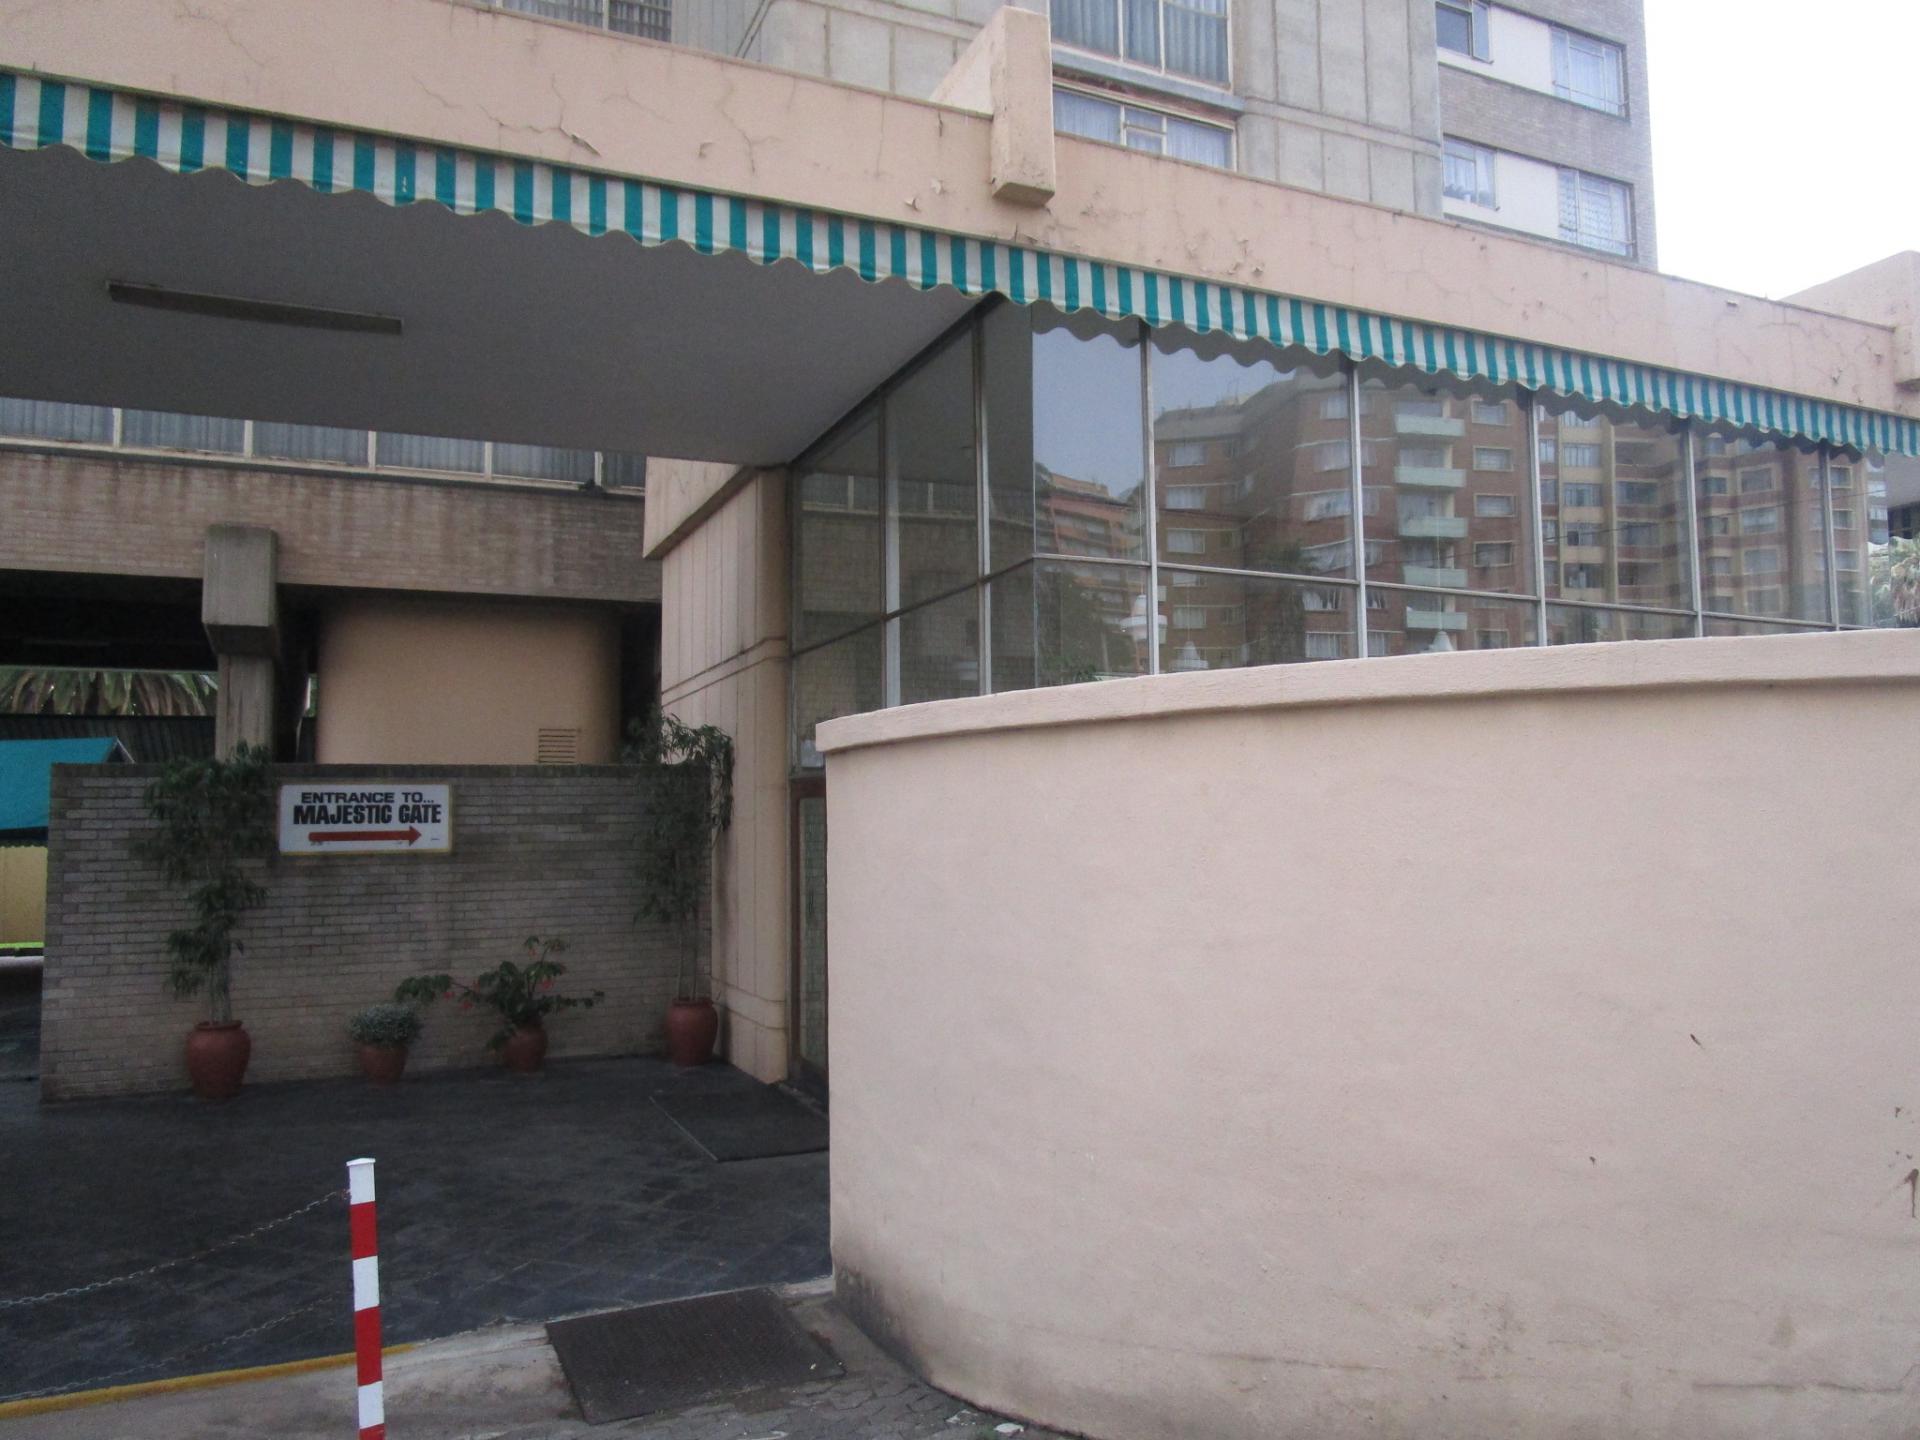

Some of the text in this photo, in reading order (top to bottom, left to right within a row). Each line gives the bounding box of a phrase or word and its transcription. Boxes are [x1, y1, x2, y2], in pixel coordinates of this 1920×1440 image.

[301, 792, 395, 804] ENTRANCE
[293, 804, 441, 825] MAJESTIC GATE
